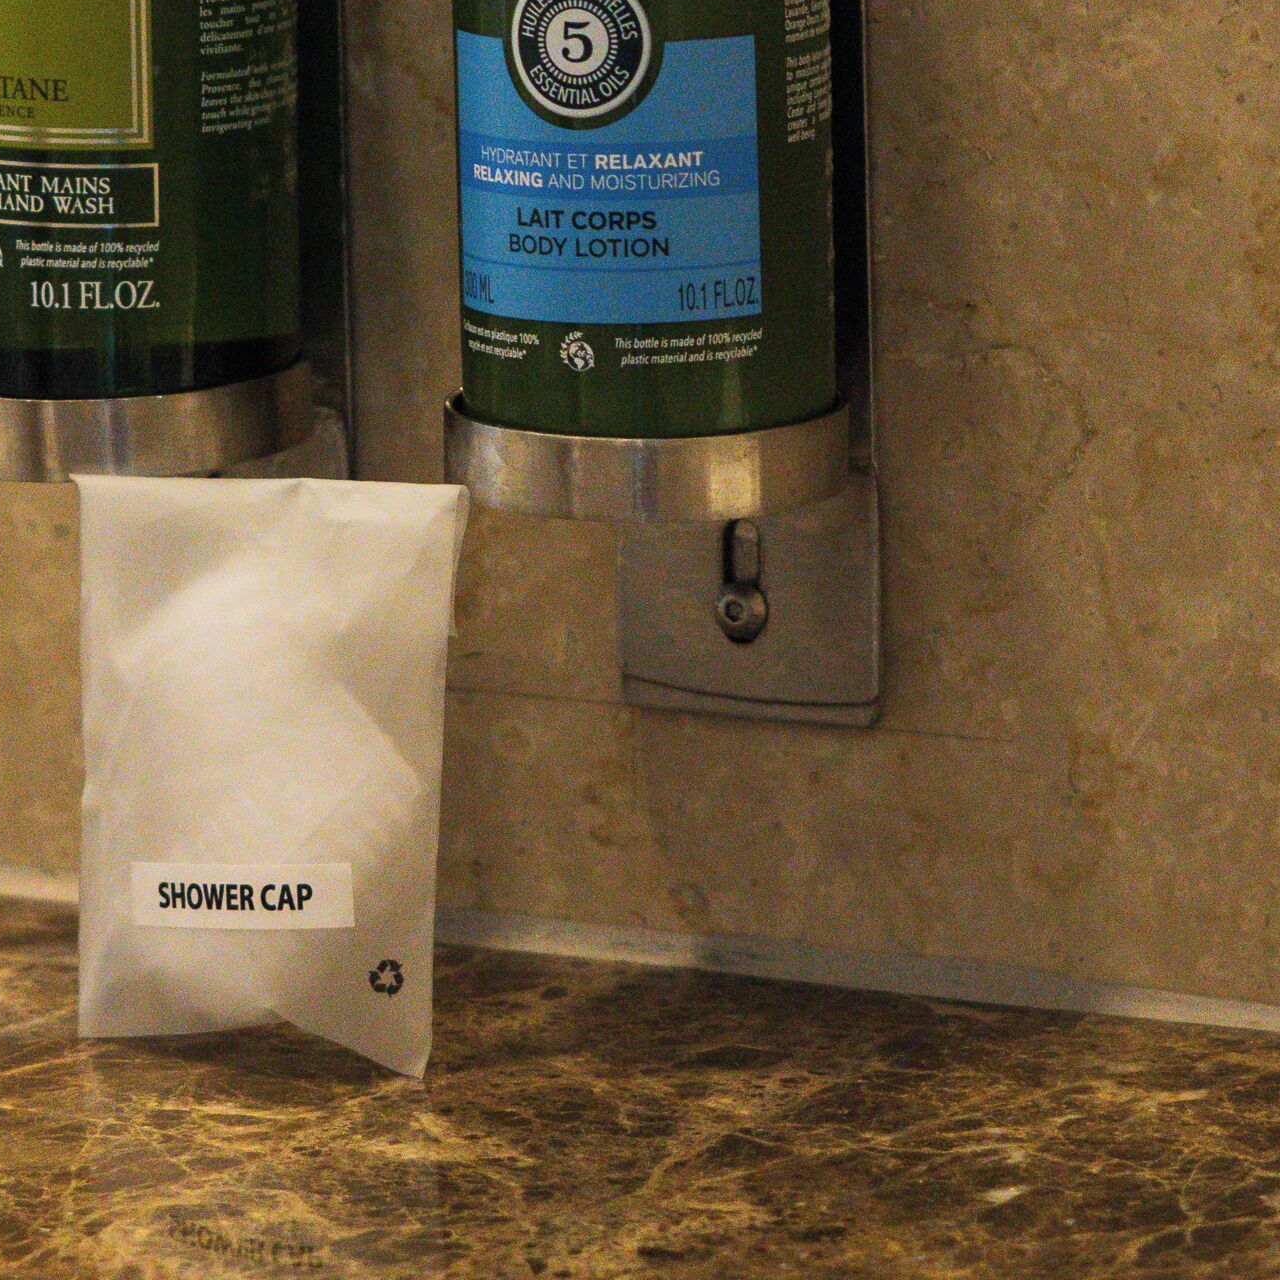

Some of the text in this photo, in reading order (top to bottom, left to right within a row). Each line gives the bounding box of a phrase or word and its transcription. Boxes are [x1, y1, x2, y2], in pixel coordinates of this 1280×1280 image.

[199, 6, 213, 17] les
[199, 18, 234, 30] toucher
[562, 21, 593, 63] 5
[201, 66, 251, 81] Formulated
[529, 64, 630, 105] ESSENTIAL OILS
[201, 107, 226, 121] touch
[480, 145, 704, 170] HYDRATANT ET RELAXANT
[41, 176, 111, 195] MAINS
[473, 164, 721, 191] RELAXING AND MOISTURIZING
[53, 196, 114, 214] WASH
[516, 206, 658, 231] LAIT CORPS
[16, 239, 160, 255] This bottle is made of 100% recycled
[508, 233, 670, 259] BODY LOTION
[20, 256, 45, 267] plastic
[46, 257, 80, 268] material
[81, 258, 98, 268] and
[99, 258, 106, 268] is
[30, 280, 160, 310] 10.1 FL.OZ.
[479, 274, 494, 304] ML
[678, 276, 759, 311] 10.1 FL.OZ.
[519, 333, 540, 346] 100%
[615, 328, 763, 349] This bottle is made of 100% recycled
[621, 353, 649, 367] plastic
[650, 351, 687, 364] material
[688, 350, 705, 363] and
[706, 349, 714, 361] is
[158, 881, 313, 911] SHOWER CAP
